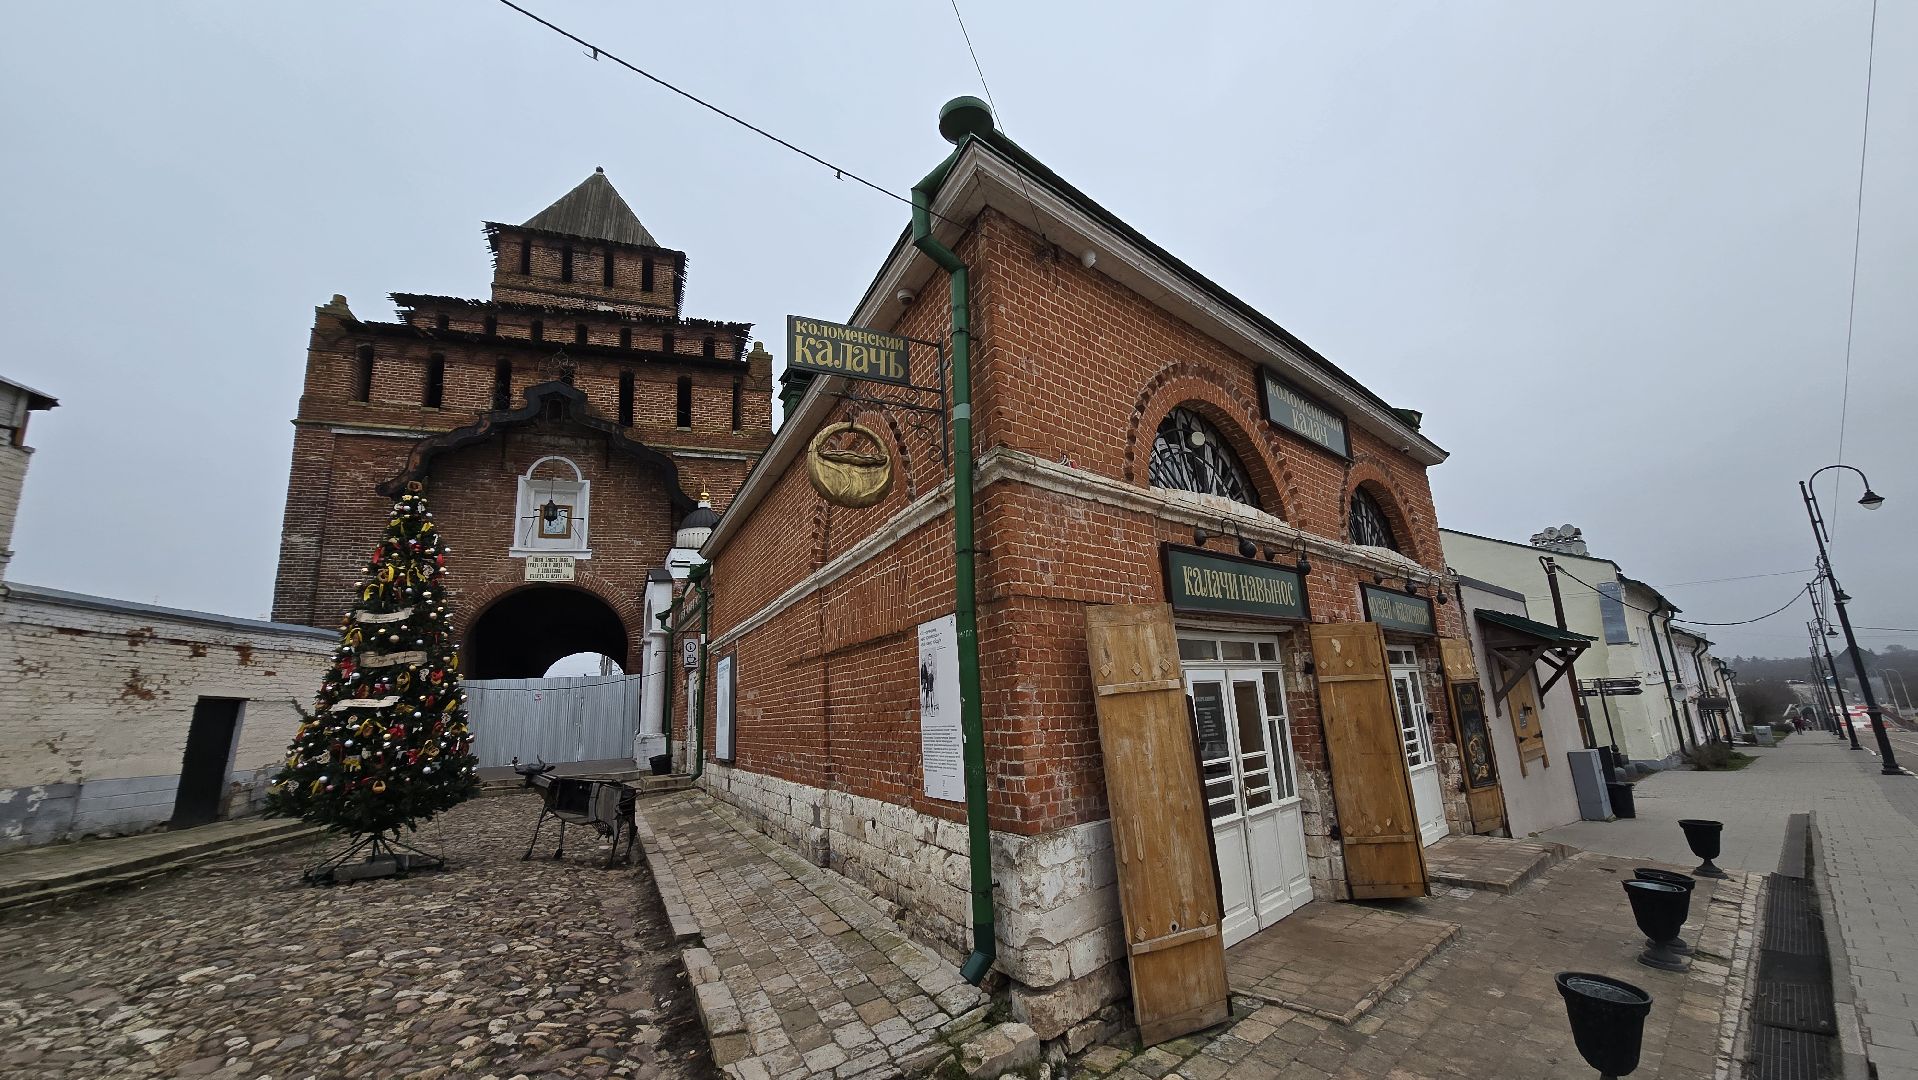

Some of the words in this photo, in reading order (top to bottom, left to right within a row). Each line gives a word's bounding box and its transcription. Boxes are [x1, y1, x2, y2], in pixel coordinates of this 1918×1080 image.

[1291, 408, 1329, 446] калач
[1182, 565, 1240, 600] калачи
[1238, 574, 1296, 607] навынос
